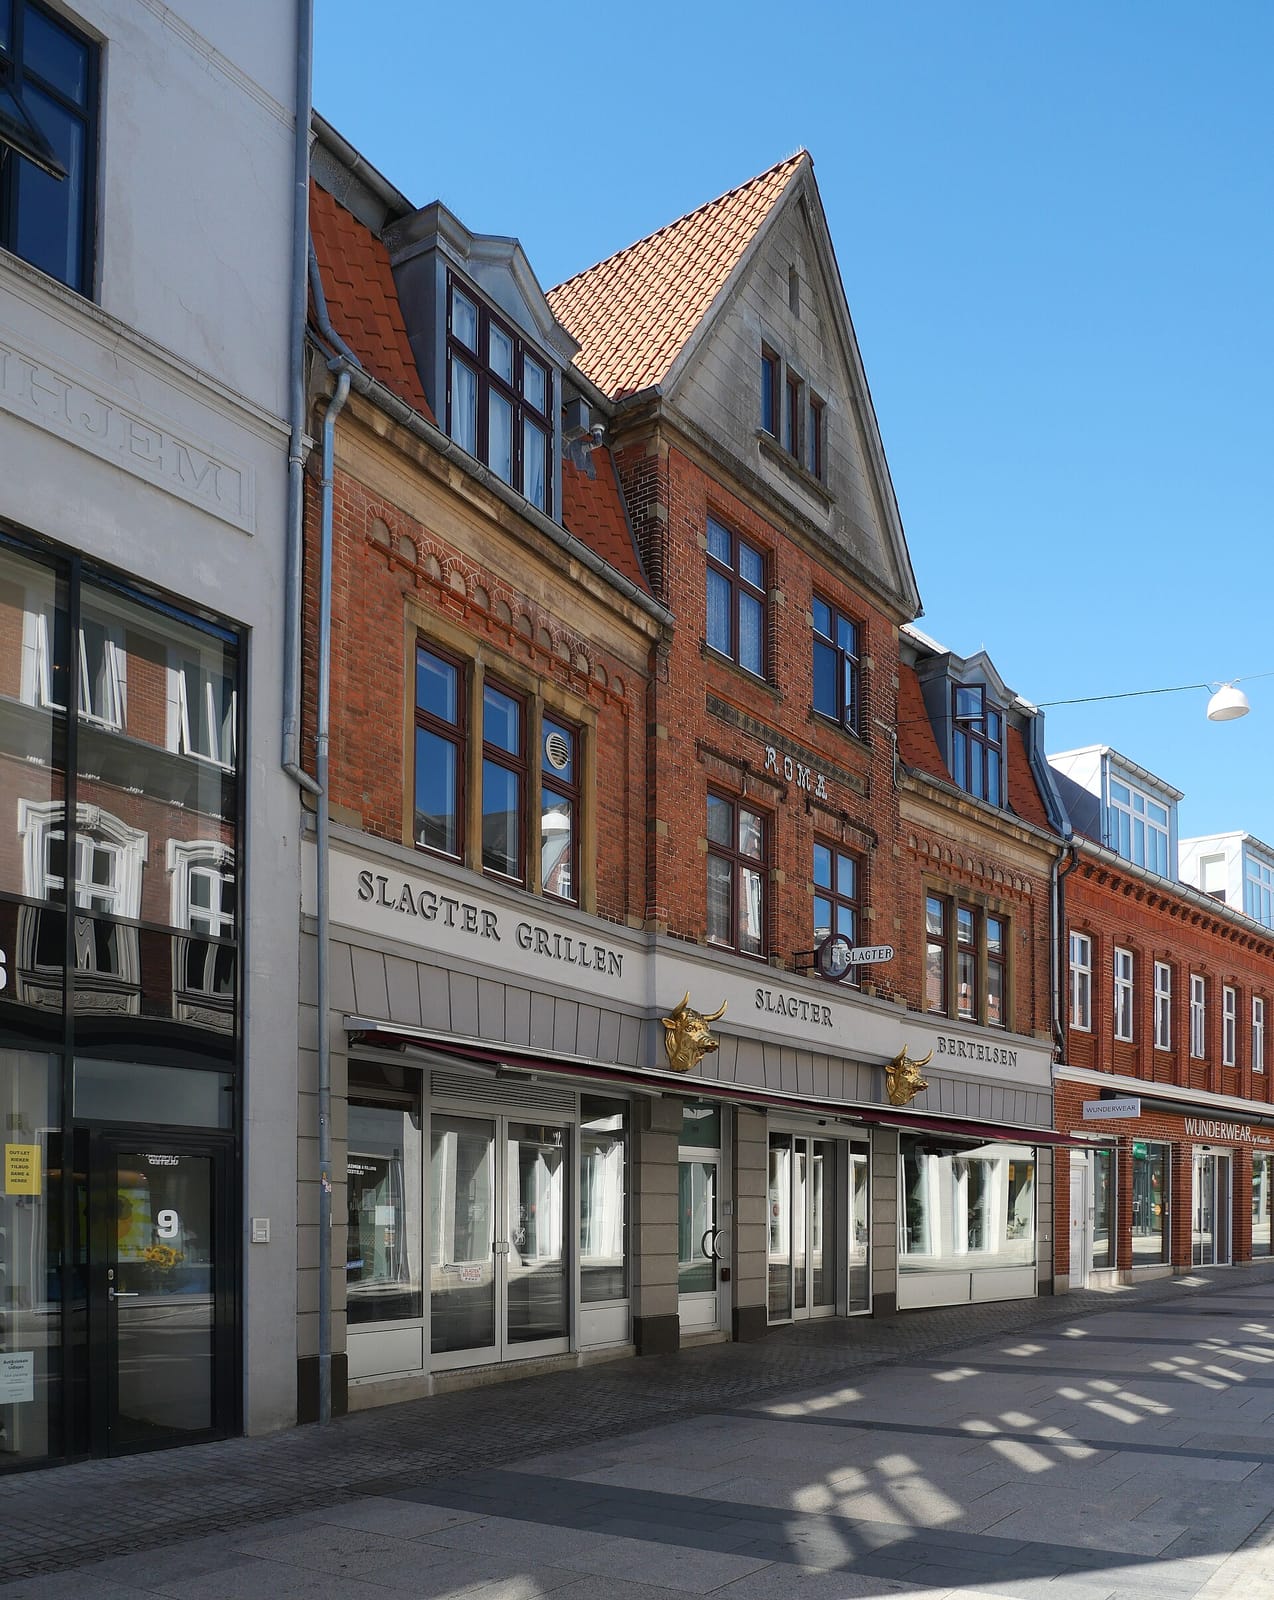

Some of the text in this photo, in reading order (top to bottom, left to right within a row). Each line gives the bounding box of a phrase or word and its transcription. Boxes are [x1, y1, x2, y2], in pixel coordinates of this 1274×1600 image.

[764, 745, 828, 800] ROMA
[357, 870, 624, 979] SLAGTER GRILLEN
[845, 948, 892, 962] SLAGTER
[755, 988, 833, 1028] SLAGTER
[936, 1036, 1018, 1068] BERTELSEN
[1086, 1104, 1137, 1114] WUNDERWEAR
[1184, 1117, 1251, 1142] WUNDERWEAR
[157, 1209, 179, 1238] 9
